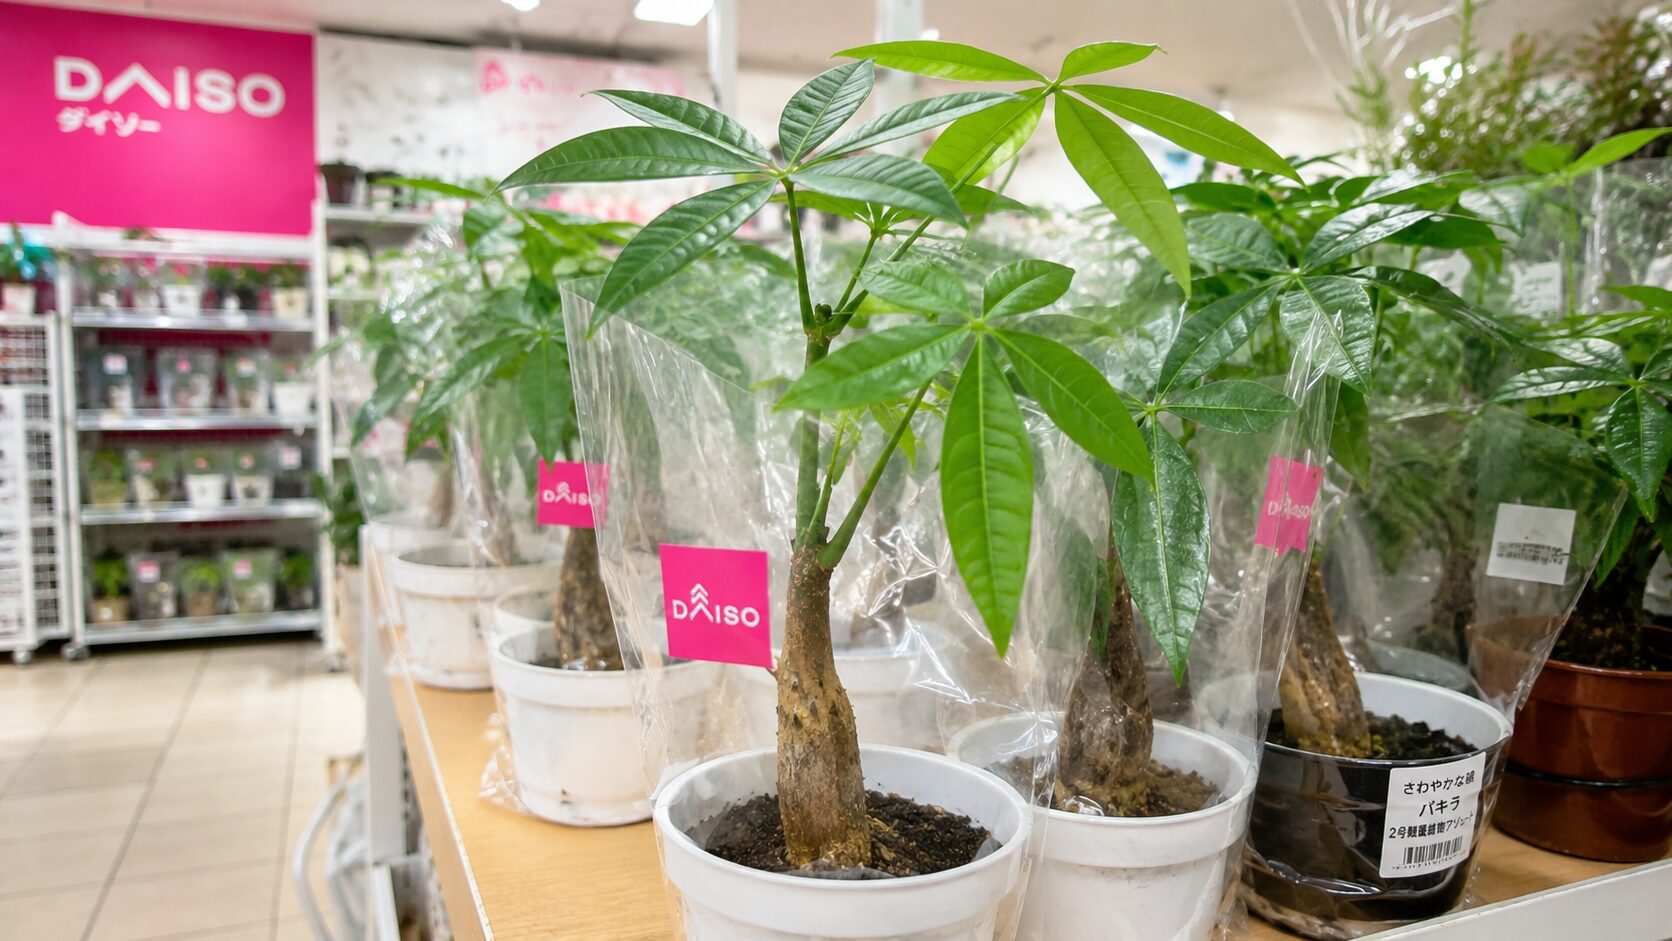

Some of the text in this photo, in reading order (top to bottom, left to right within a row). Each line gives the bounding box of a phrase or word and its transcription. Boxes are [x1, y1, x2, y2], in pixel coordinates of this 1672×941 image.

[53, 56, 286, 119] DAISO
[56, 107, 162, 138] ダイソー
[543, 481, 602, 507] DAISO
[672, 584, 760, 628] DAISO
